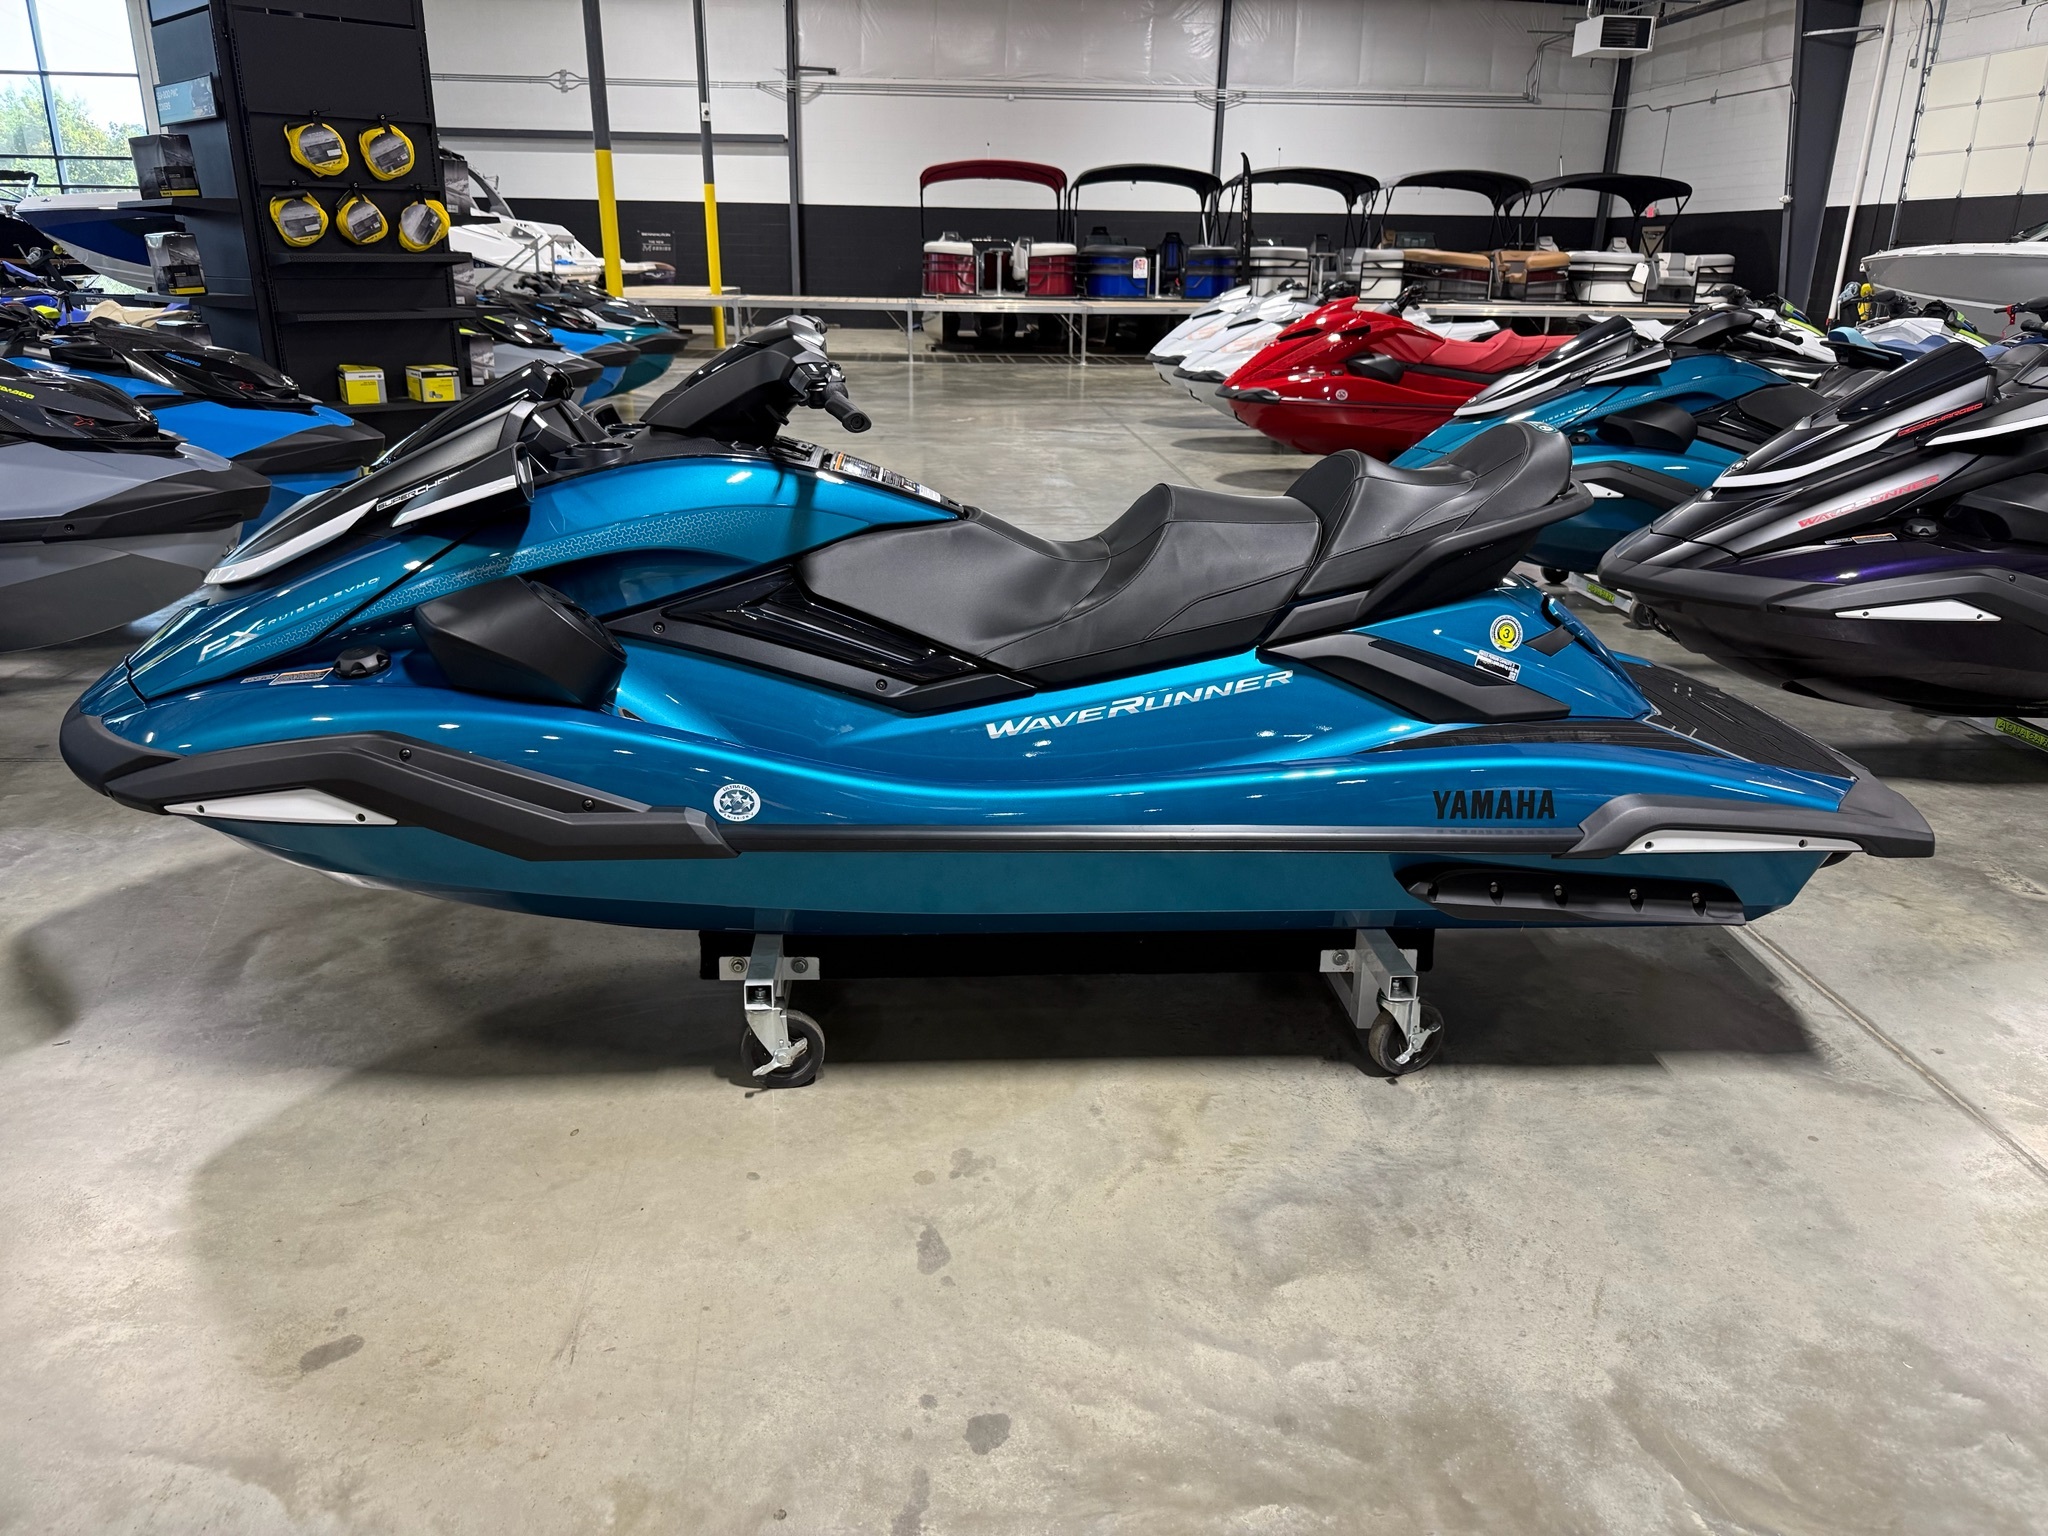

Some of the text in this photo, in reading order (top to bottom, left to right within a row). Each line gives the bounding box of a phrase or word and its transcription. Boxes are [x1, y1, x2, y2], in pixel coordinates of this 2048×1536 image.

[197, 576, 381, 663] FX CRUISER SVHO
[1502, 628, 1511, 639] 3
[985, 669, 1295, 740] WAVERUNNER
[1997, 718, 2048, 748] AQUACAR
[722, 784, 754, 794] ULTRA LOW
[1432, 789, 1556, 820] YAMAHA
